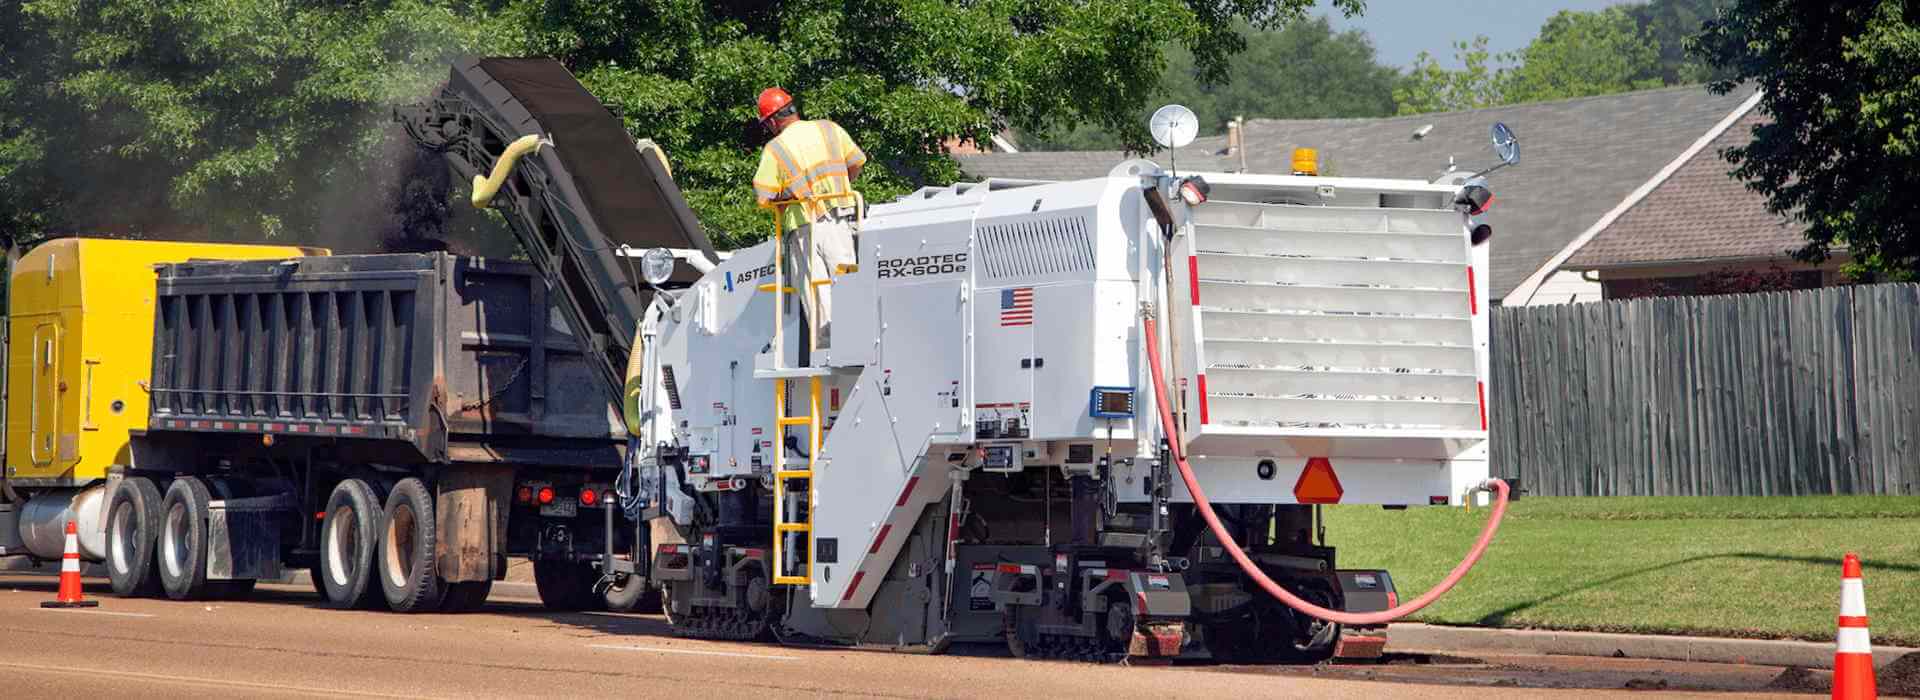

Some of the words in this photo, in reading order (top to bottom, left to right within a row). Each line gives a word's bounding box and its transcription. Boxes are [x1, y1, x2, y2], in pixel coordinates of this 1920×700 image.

[878, 253, 967, 269] ROADTEC
[737, 263, 776, 284] ASTEC
[878, 264, 966, 279] RX-600e
